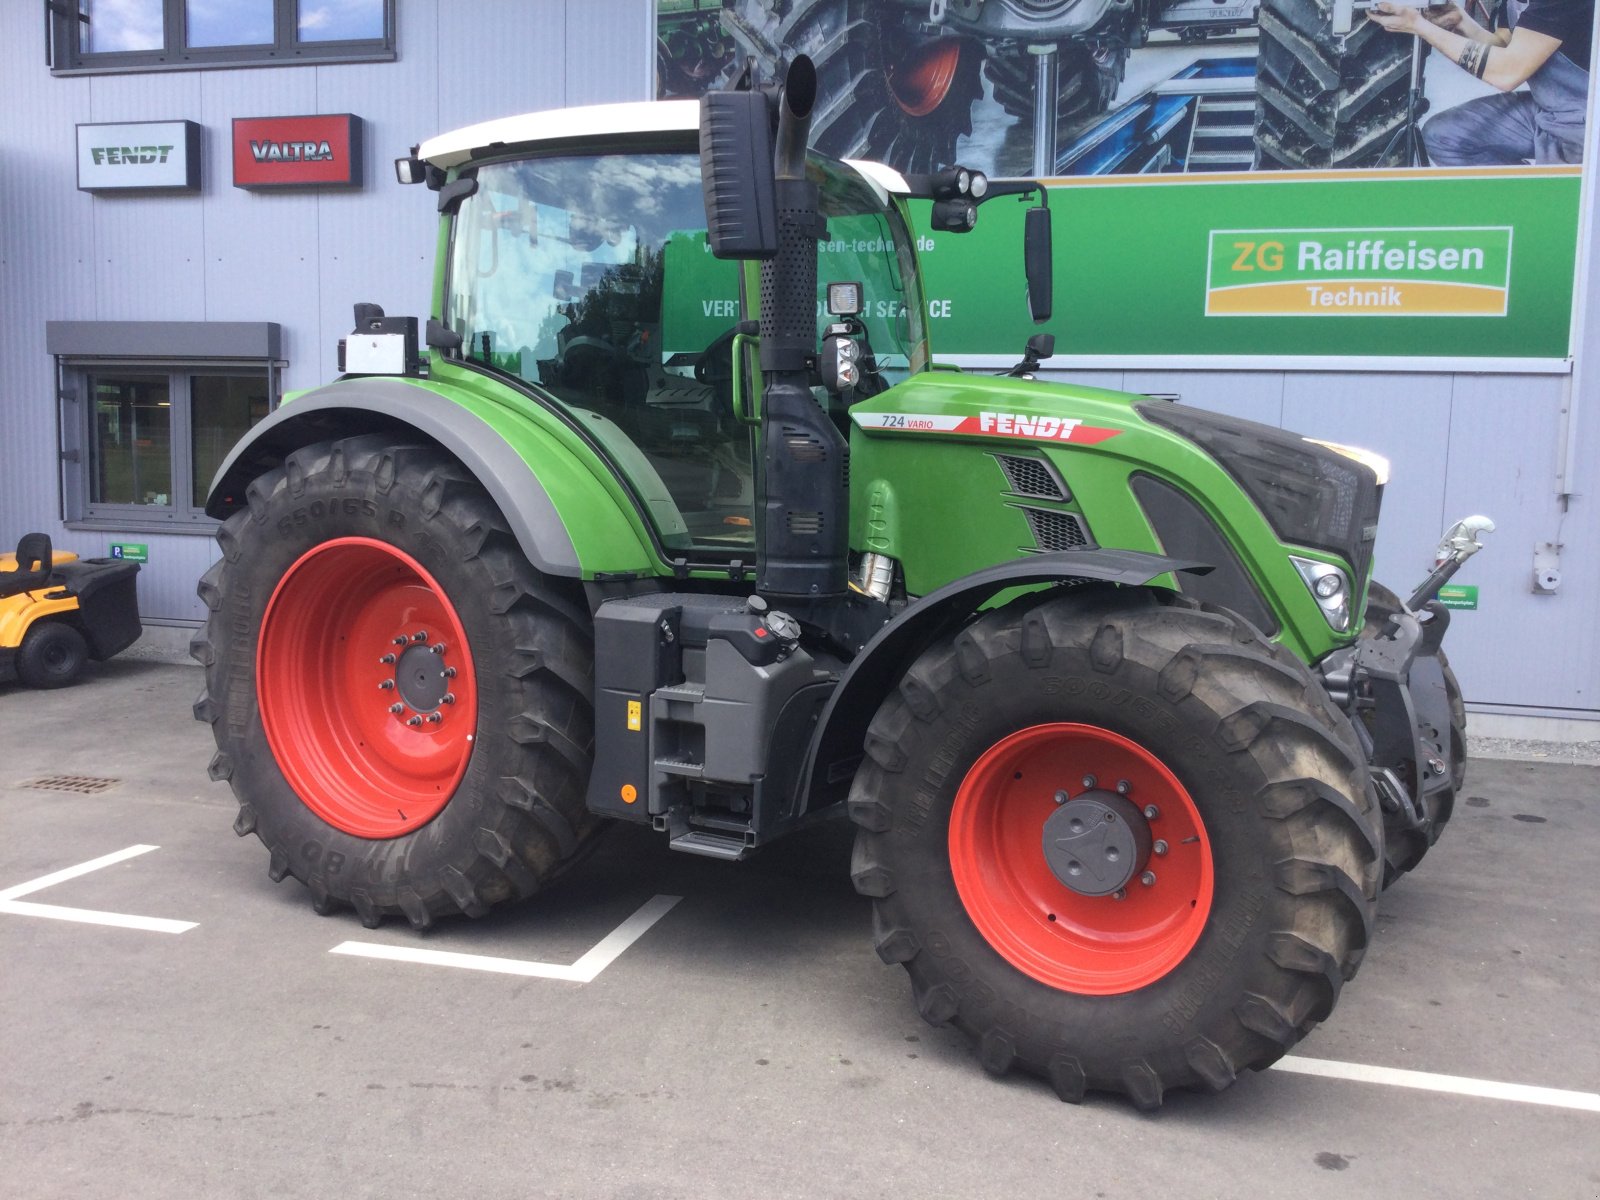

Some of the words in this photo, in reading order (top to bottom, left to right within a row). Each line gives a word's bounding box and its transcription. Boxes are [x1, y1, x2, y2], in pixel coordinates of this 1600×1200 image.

[90, 145, 174, 166] FENDT
[250, 139, 334, 163] VALTRA
[1231, 241, 1285, 272] ZG
[1297, 240, 1485, 271] Raiffeisen
[1306, 286, 1402, 307] Technik
[882, 415, 905, 428] 724
[907, 419, 934, 430] VARIO
[979, 411, 1083, 439] FENDT
